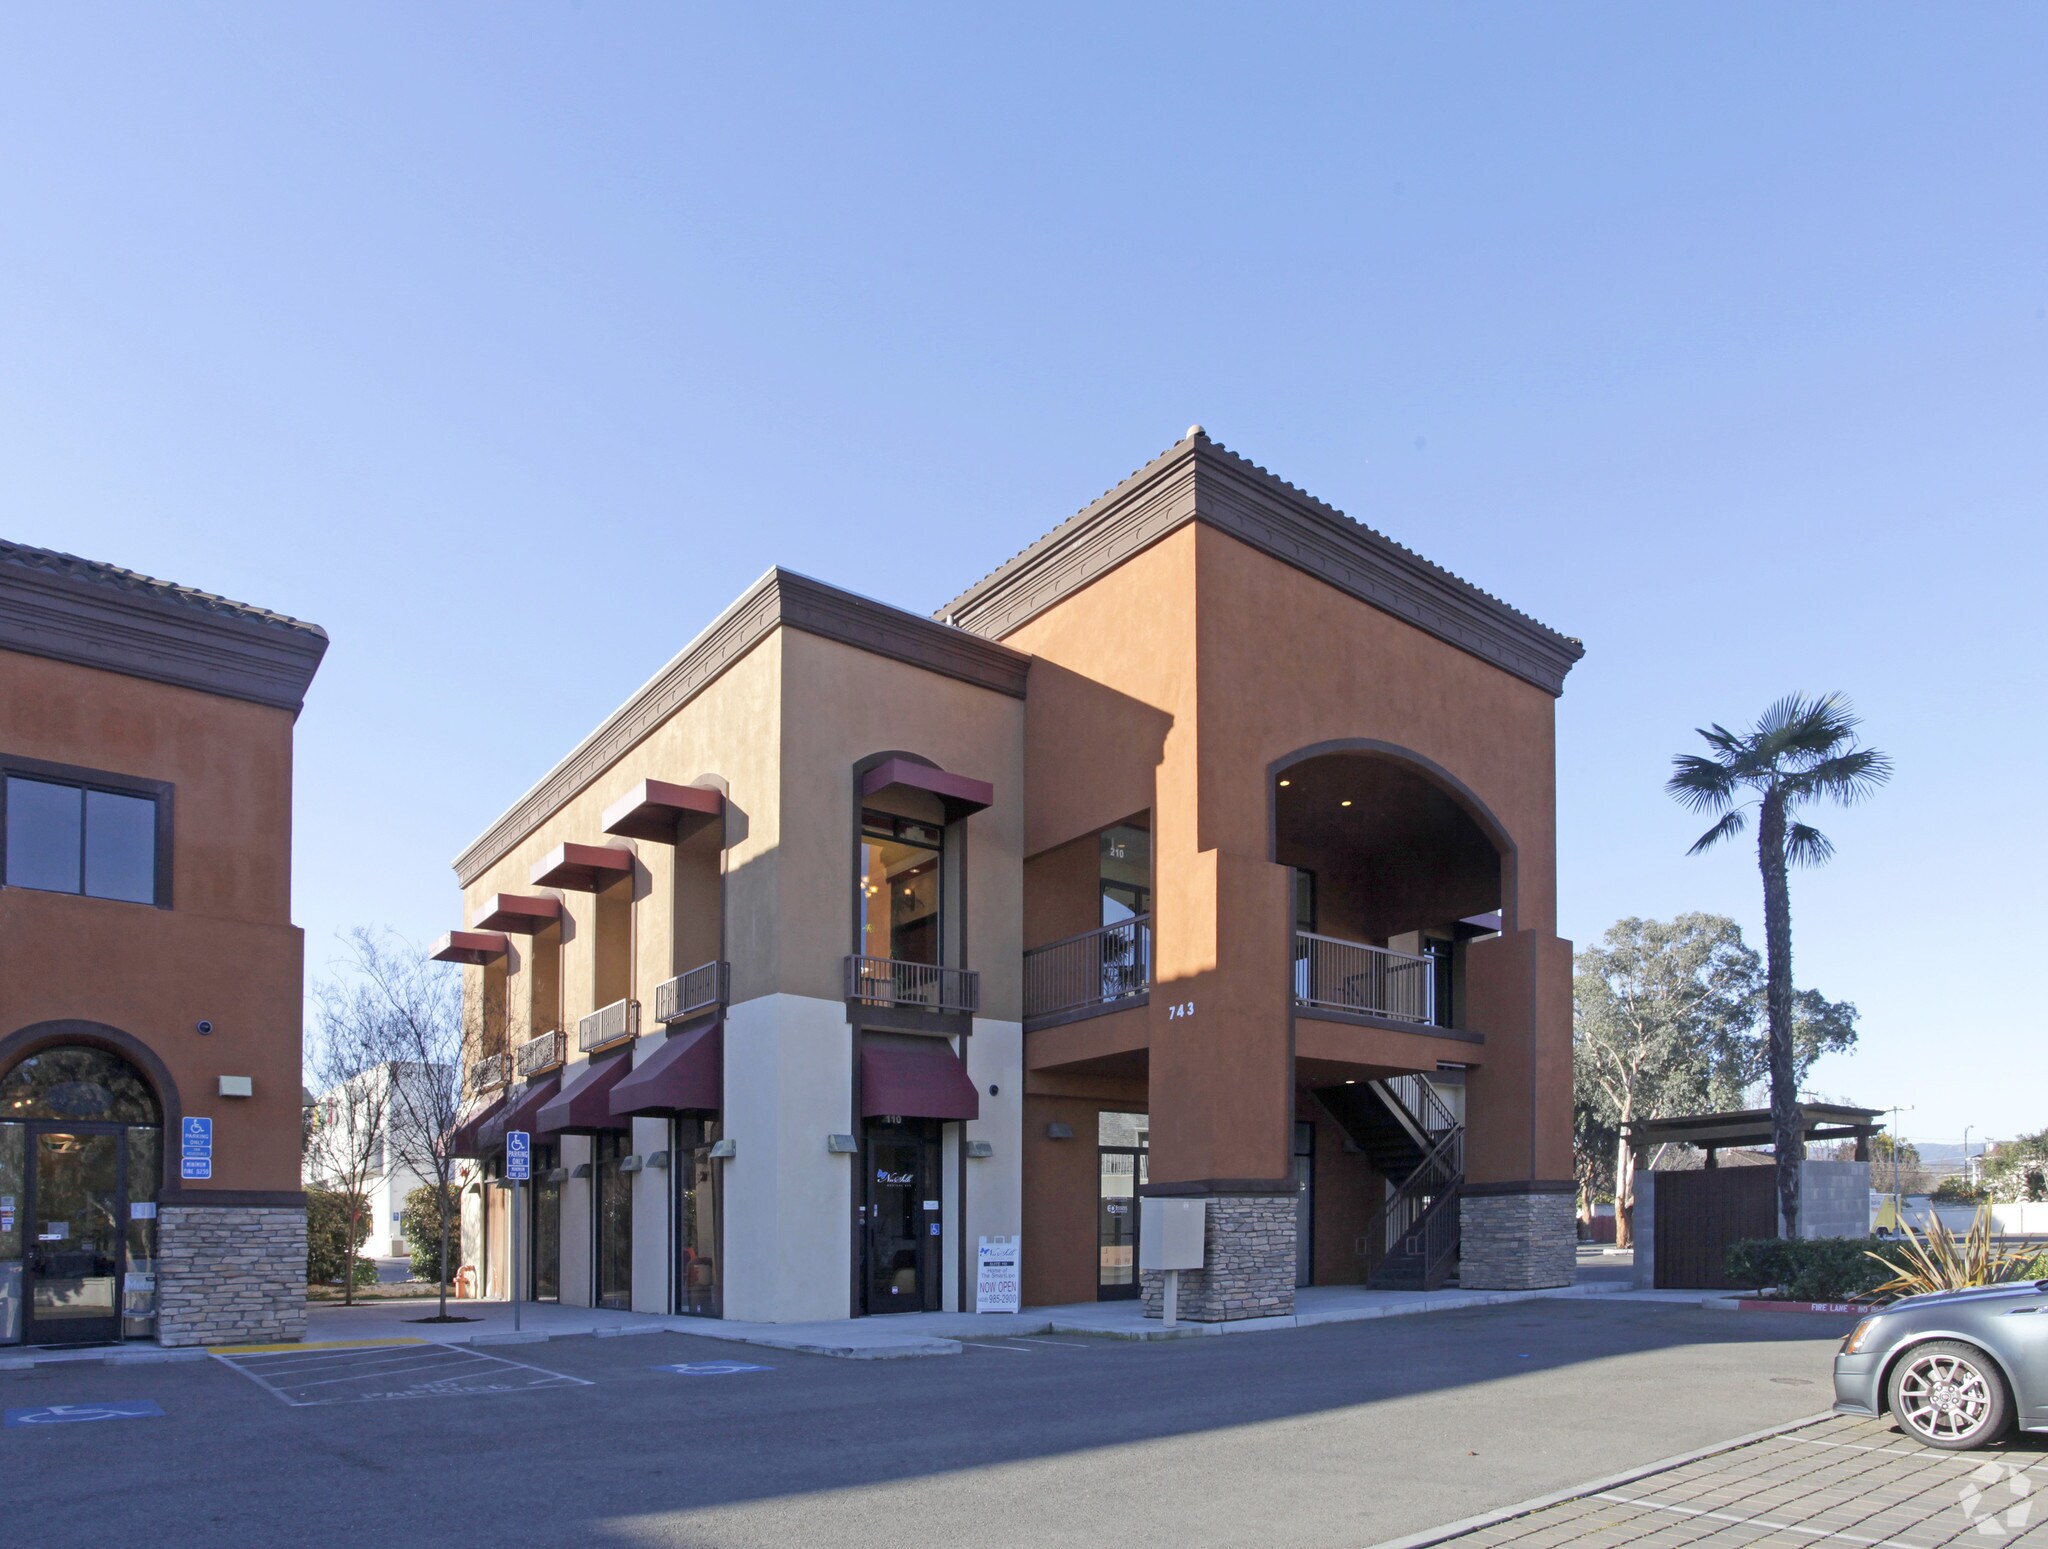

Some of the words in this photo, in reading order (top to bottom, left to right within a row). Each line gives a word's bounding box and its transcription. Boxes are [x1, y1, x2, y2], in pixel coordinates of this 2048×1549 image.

[1110, 847, 1124, 859] 210
[1168, 1002, 1195, 1020] 743
[886, 1115, 902, 1124] 110
[508, 1150, 528, 1158] PARKING
[511, 1157, 524, 1165] ONLY
[980, 1281, 996, 1293] NOW
[998, 1281, 1017, 1293] OPEN
[988, 1294, 1017, 1304] 985-2900
[1811, 1303, 1827, 1311] FIRE
[1830, 1304, 1848, 1312] LANE
[1858, 1305, 1868, 1313] NO
